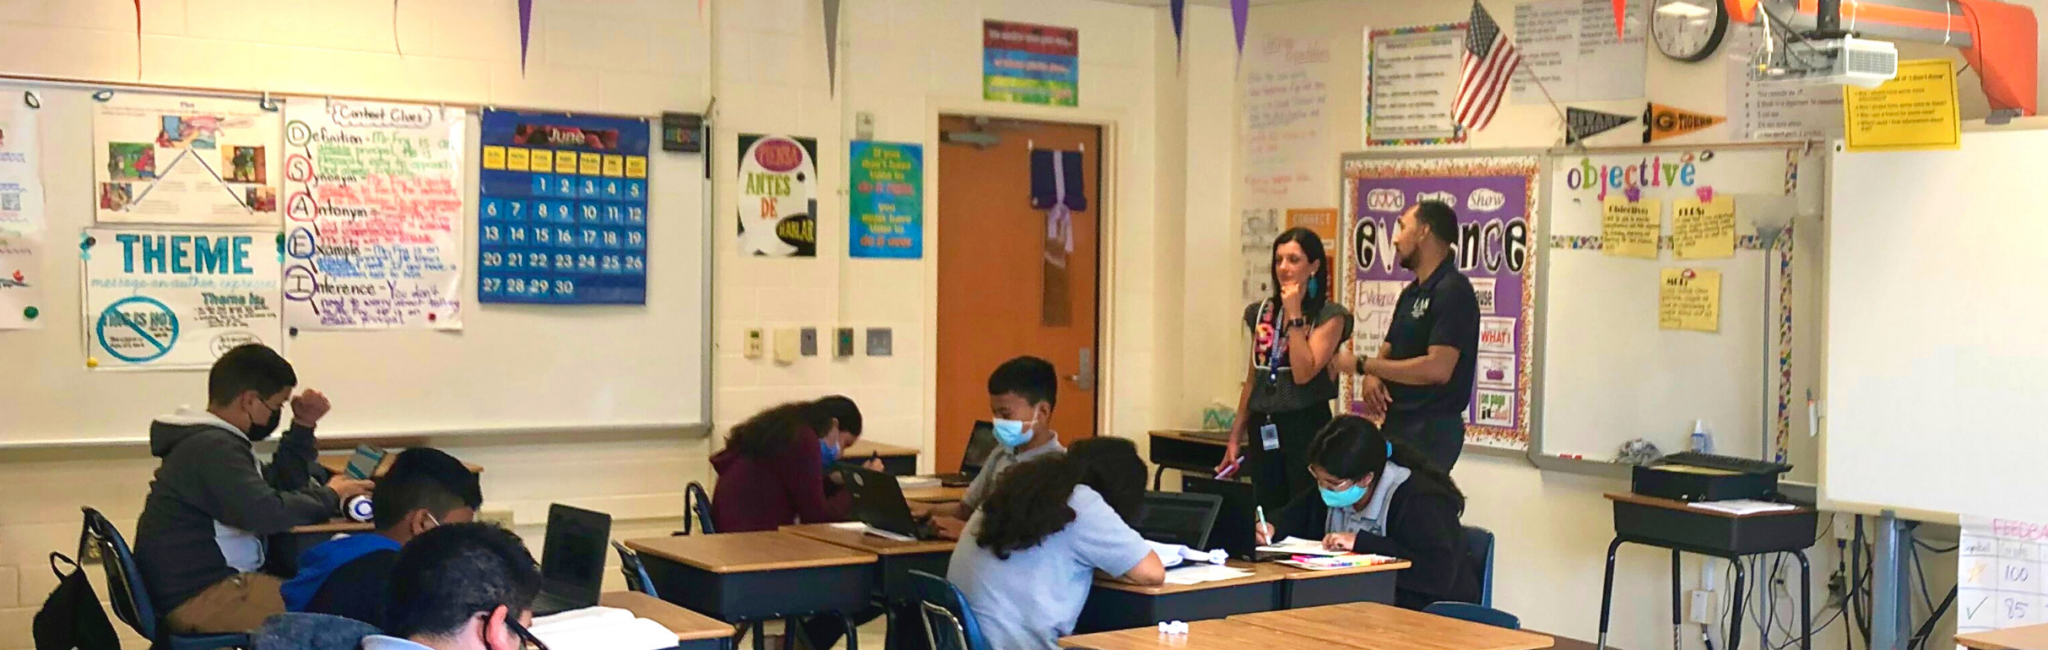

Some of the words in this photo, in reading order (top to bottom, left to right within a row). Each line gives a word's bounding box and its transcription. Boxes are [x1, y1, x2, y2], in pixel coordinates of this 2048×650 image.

[339, 107, 385, 121] Context
[390, 109, 424, 122] Clues
[547, 126, 585, 144] June
[540, 178, 546, 190] 1
[561, 178, 569, 193] 2
[585, 180, 594, 194] 3
[607, 182, 616, 195] 4
[631, 183, 639, 198] 5
[746, 171, 791, 196] ANTES
[1567, 156, 1696, 202] objective
[487, 202, 496, 216] 6
[512, 202, 520, 216] 7
[538, 203, 547, 217] 8
[559, 205, 568, 218] 9
[583, 205, 597, 218] 10
[608, 206, 618, 219] 11
[629, 208, 642, 220] 12
[761, 197, 778, 219] DE
[485, 226, 499, 240] 13
[510, 227, 525, 241] 14
[535, 228, 549, 242] 15
[557, 230, 571, 243] 16
[583, 230, 596, 243] 17
[603, 231, 616, 244] 18
[628, 232, 641, 244] 19
[1356, 217, 1526, 272] evnce
[116, 234, 254, 275] THEME
[483, 252, 501, 266] 20
[507, 252, 523, 266] 21
[529, 253, 547, 267] 22
[555, 254, 573, 268] 23
[578, 254, 595, 268] 24
[602, 255, 619, 269] 25
[626, 256, 642, 269] 26
[483, 278, 501, 292] 27
[506, 279, 525, 293] 28
[529, 279, 549, 293] 29
[555, 280, 573, 293] 30
[1481, 331, 1505, 343] WHAT
[2005, 564, 2028, 582] 100
[2004, 597, 2029, 620] 85
